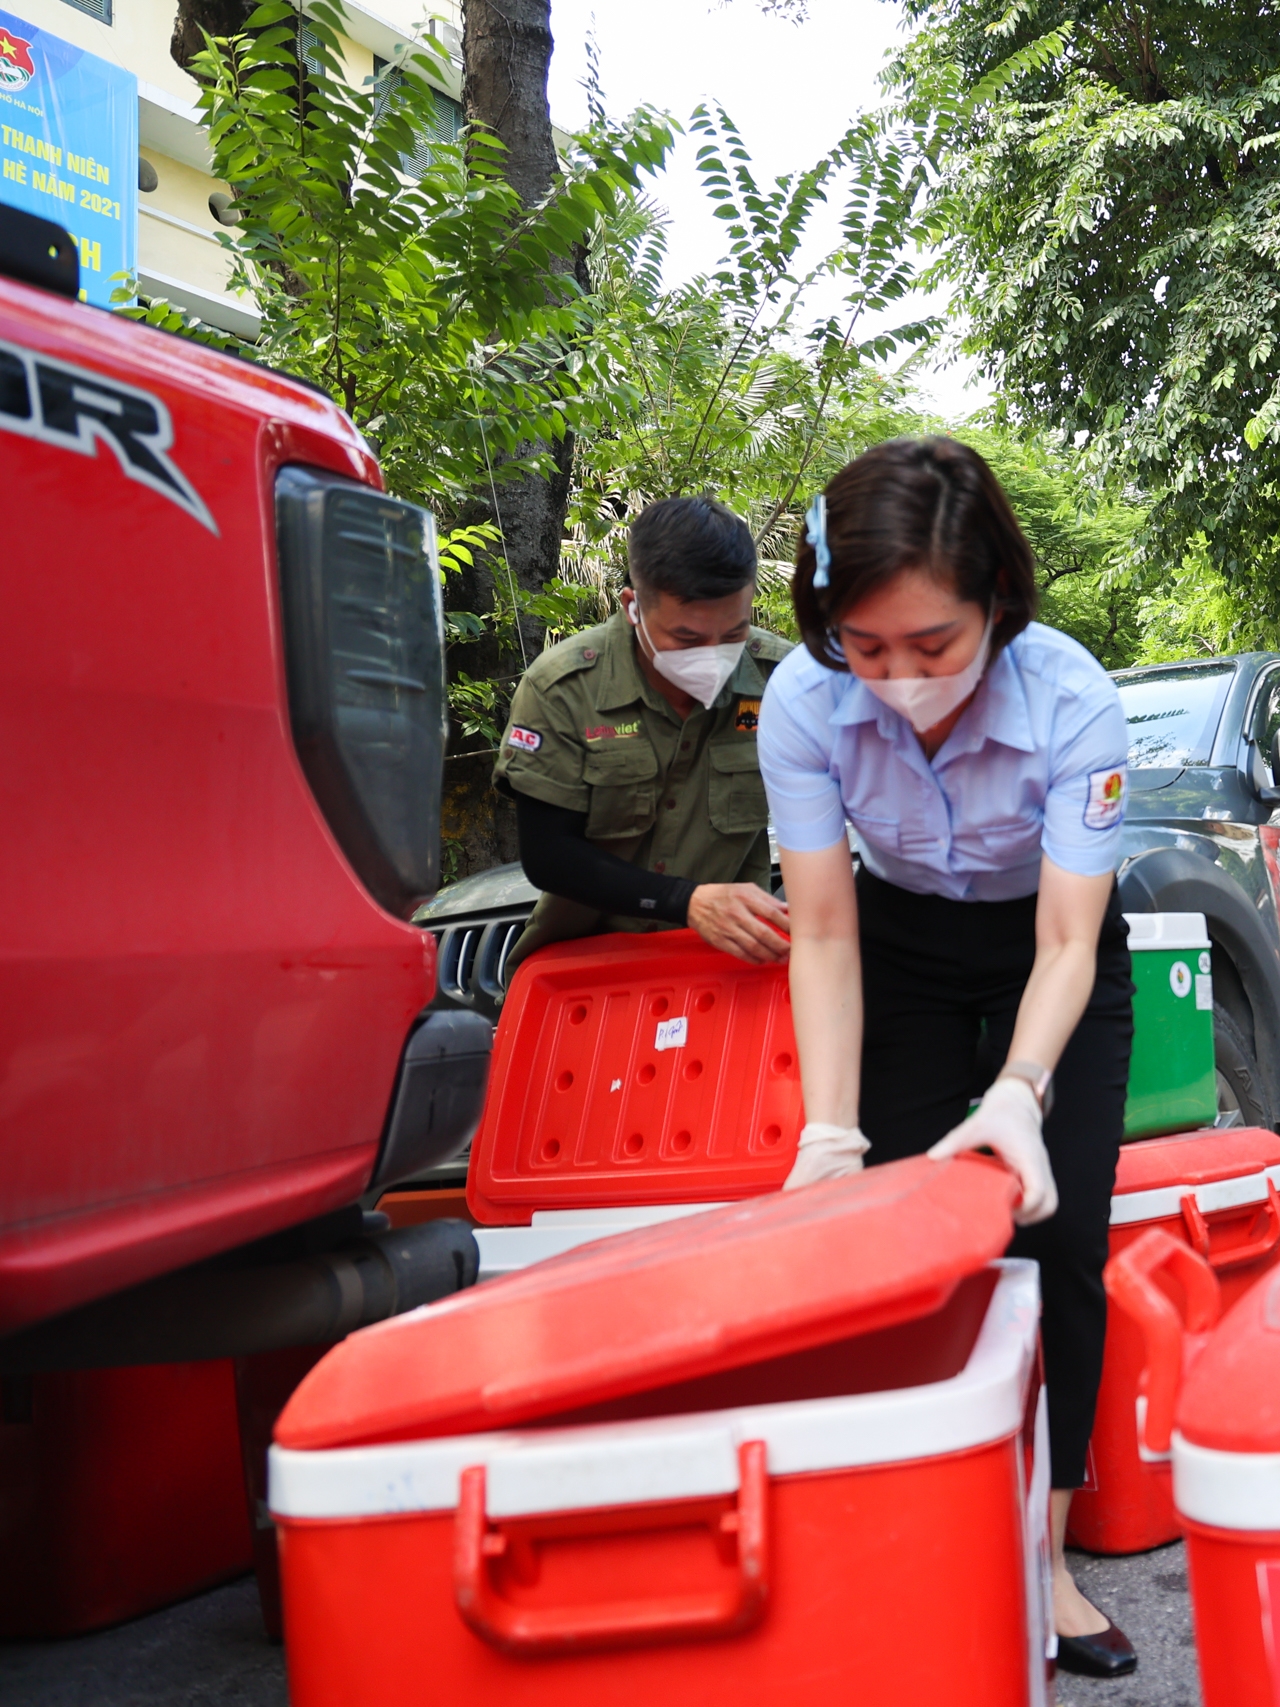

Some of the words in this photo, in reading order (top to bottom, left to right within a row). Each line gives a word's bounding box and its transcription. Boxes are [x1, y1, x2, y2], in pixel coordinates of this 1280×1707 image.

[1, 124, 62, 167] THANH
[67, 151, 109, 186] NIÊN
[3, 157, 27, 186] HÈ
[32, 171, 76, 204] NĂM
[79, 188, 121, 221] 2021
